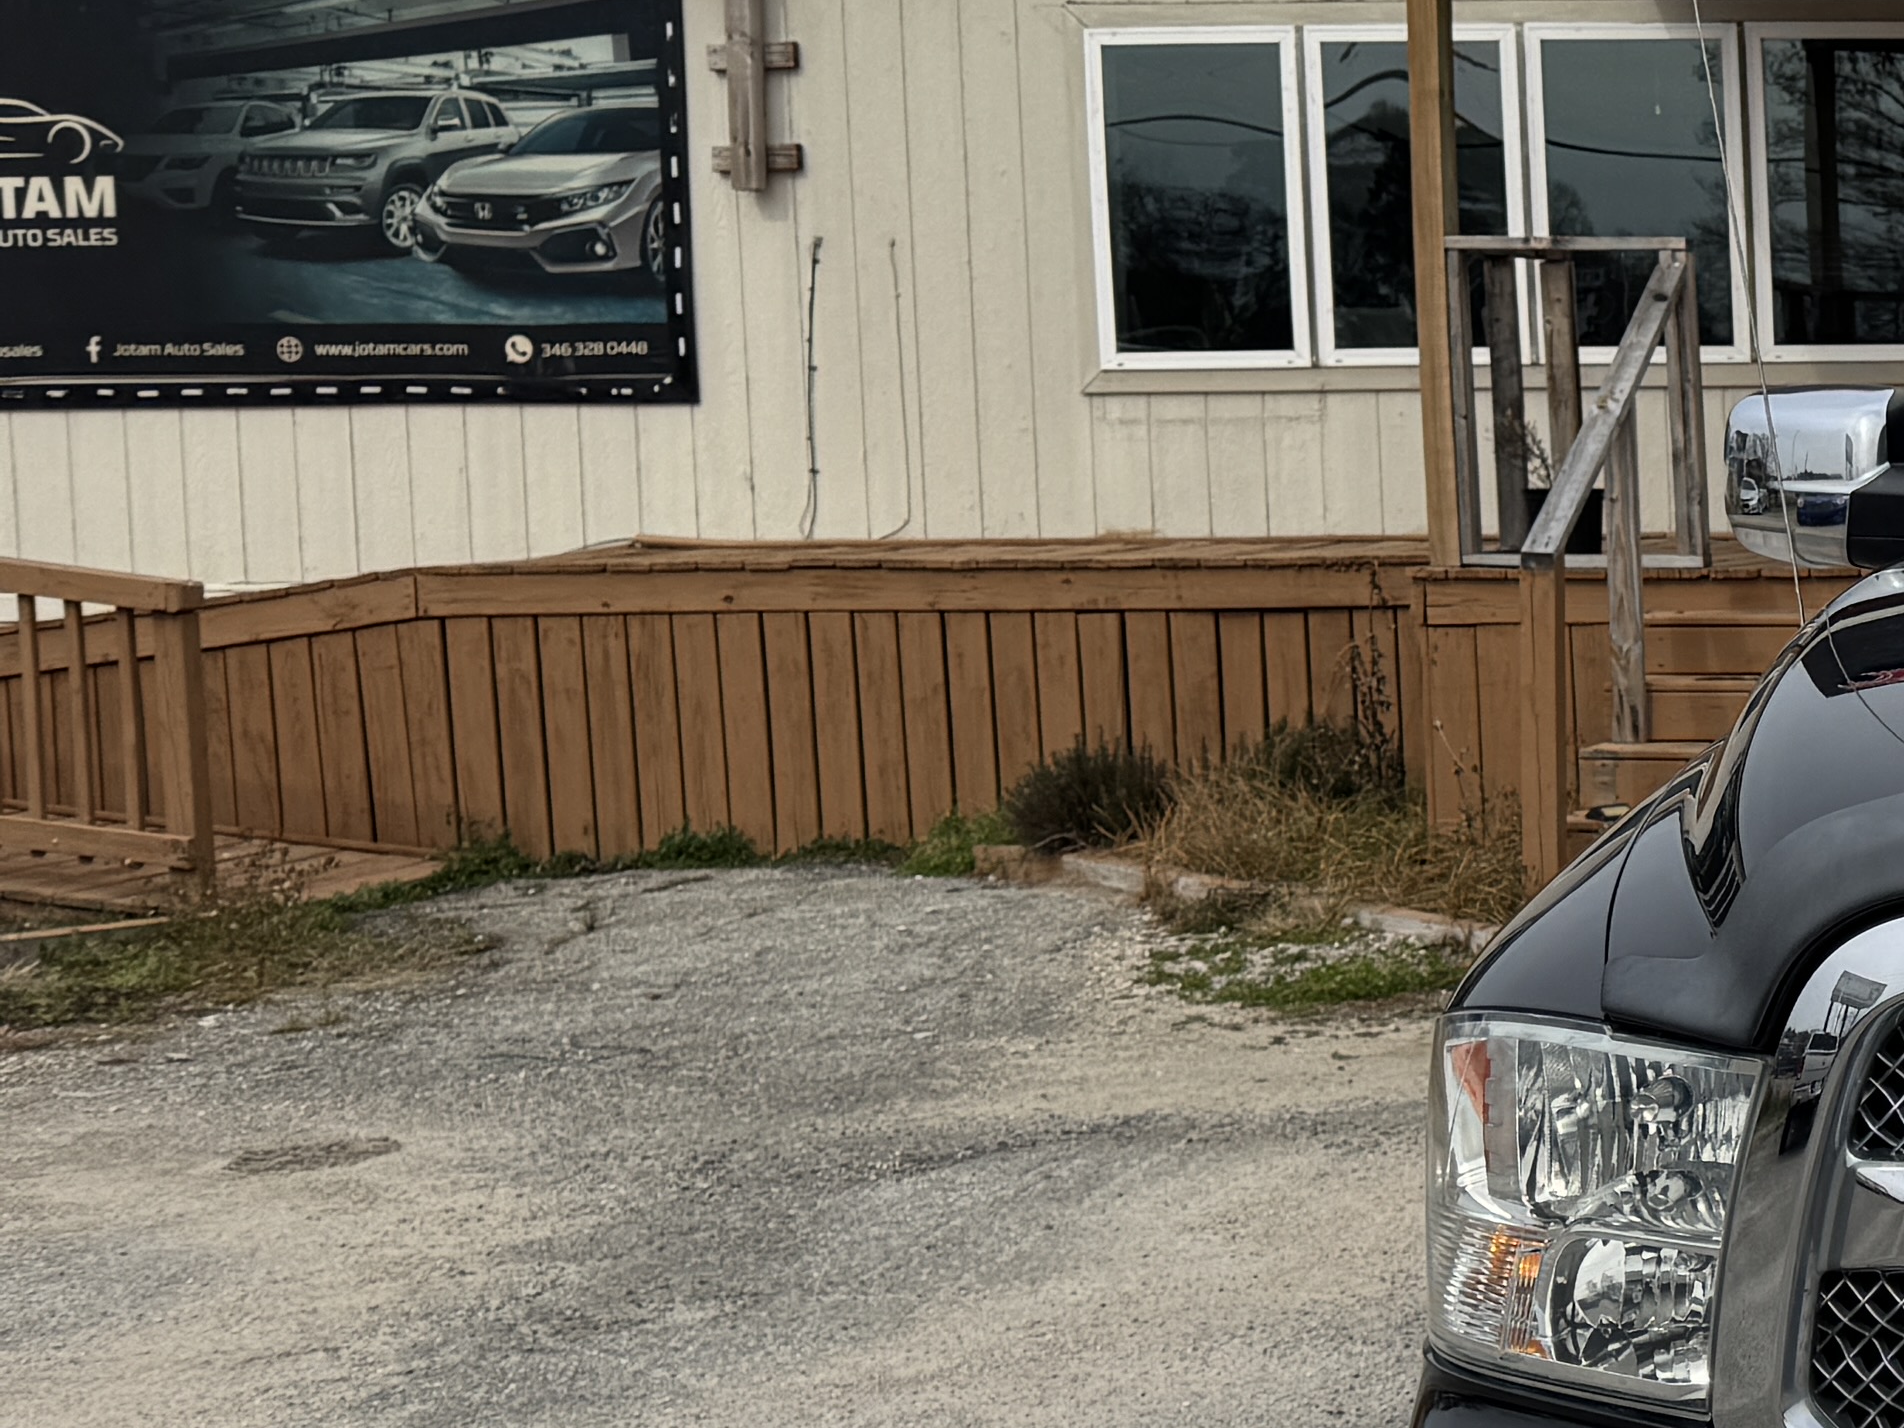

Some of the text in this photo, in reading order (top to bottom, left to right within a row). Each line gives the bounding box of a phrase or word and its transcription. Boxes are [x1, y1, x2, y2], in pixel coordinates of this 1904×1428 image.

[0, 176, 117, 219] TAM
[46, 228, 118, 246] SALES
[113, 342, 245, 356] Jotam Auto Sales
[314, 341, 469, 357] www.jotamcars.com
[541, 343, 572, 357] 346
